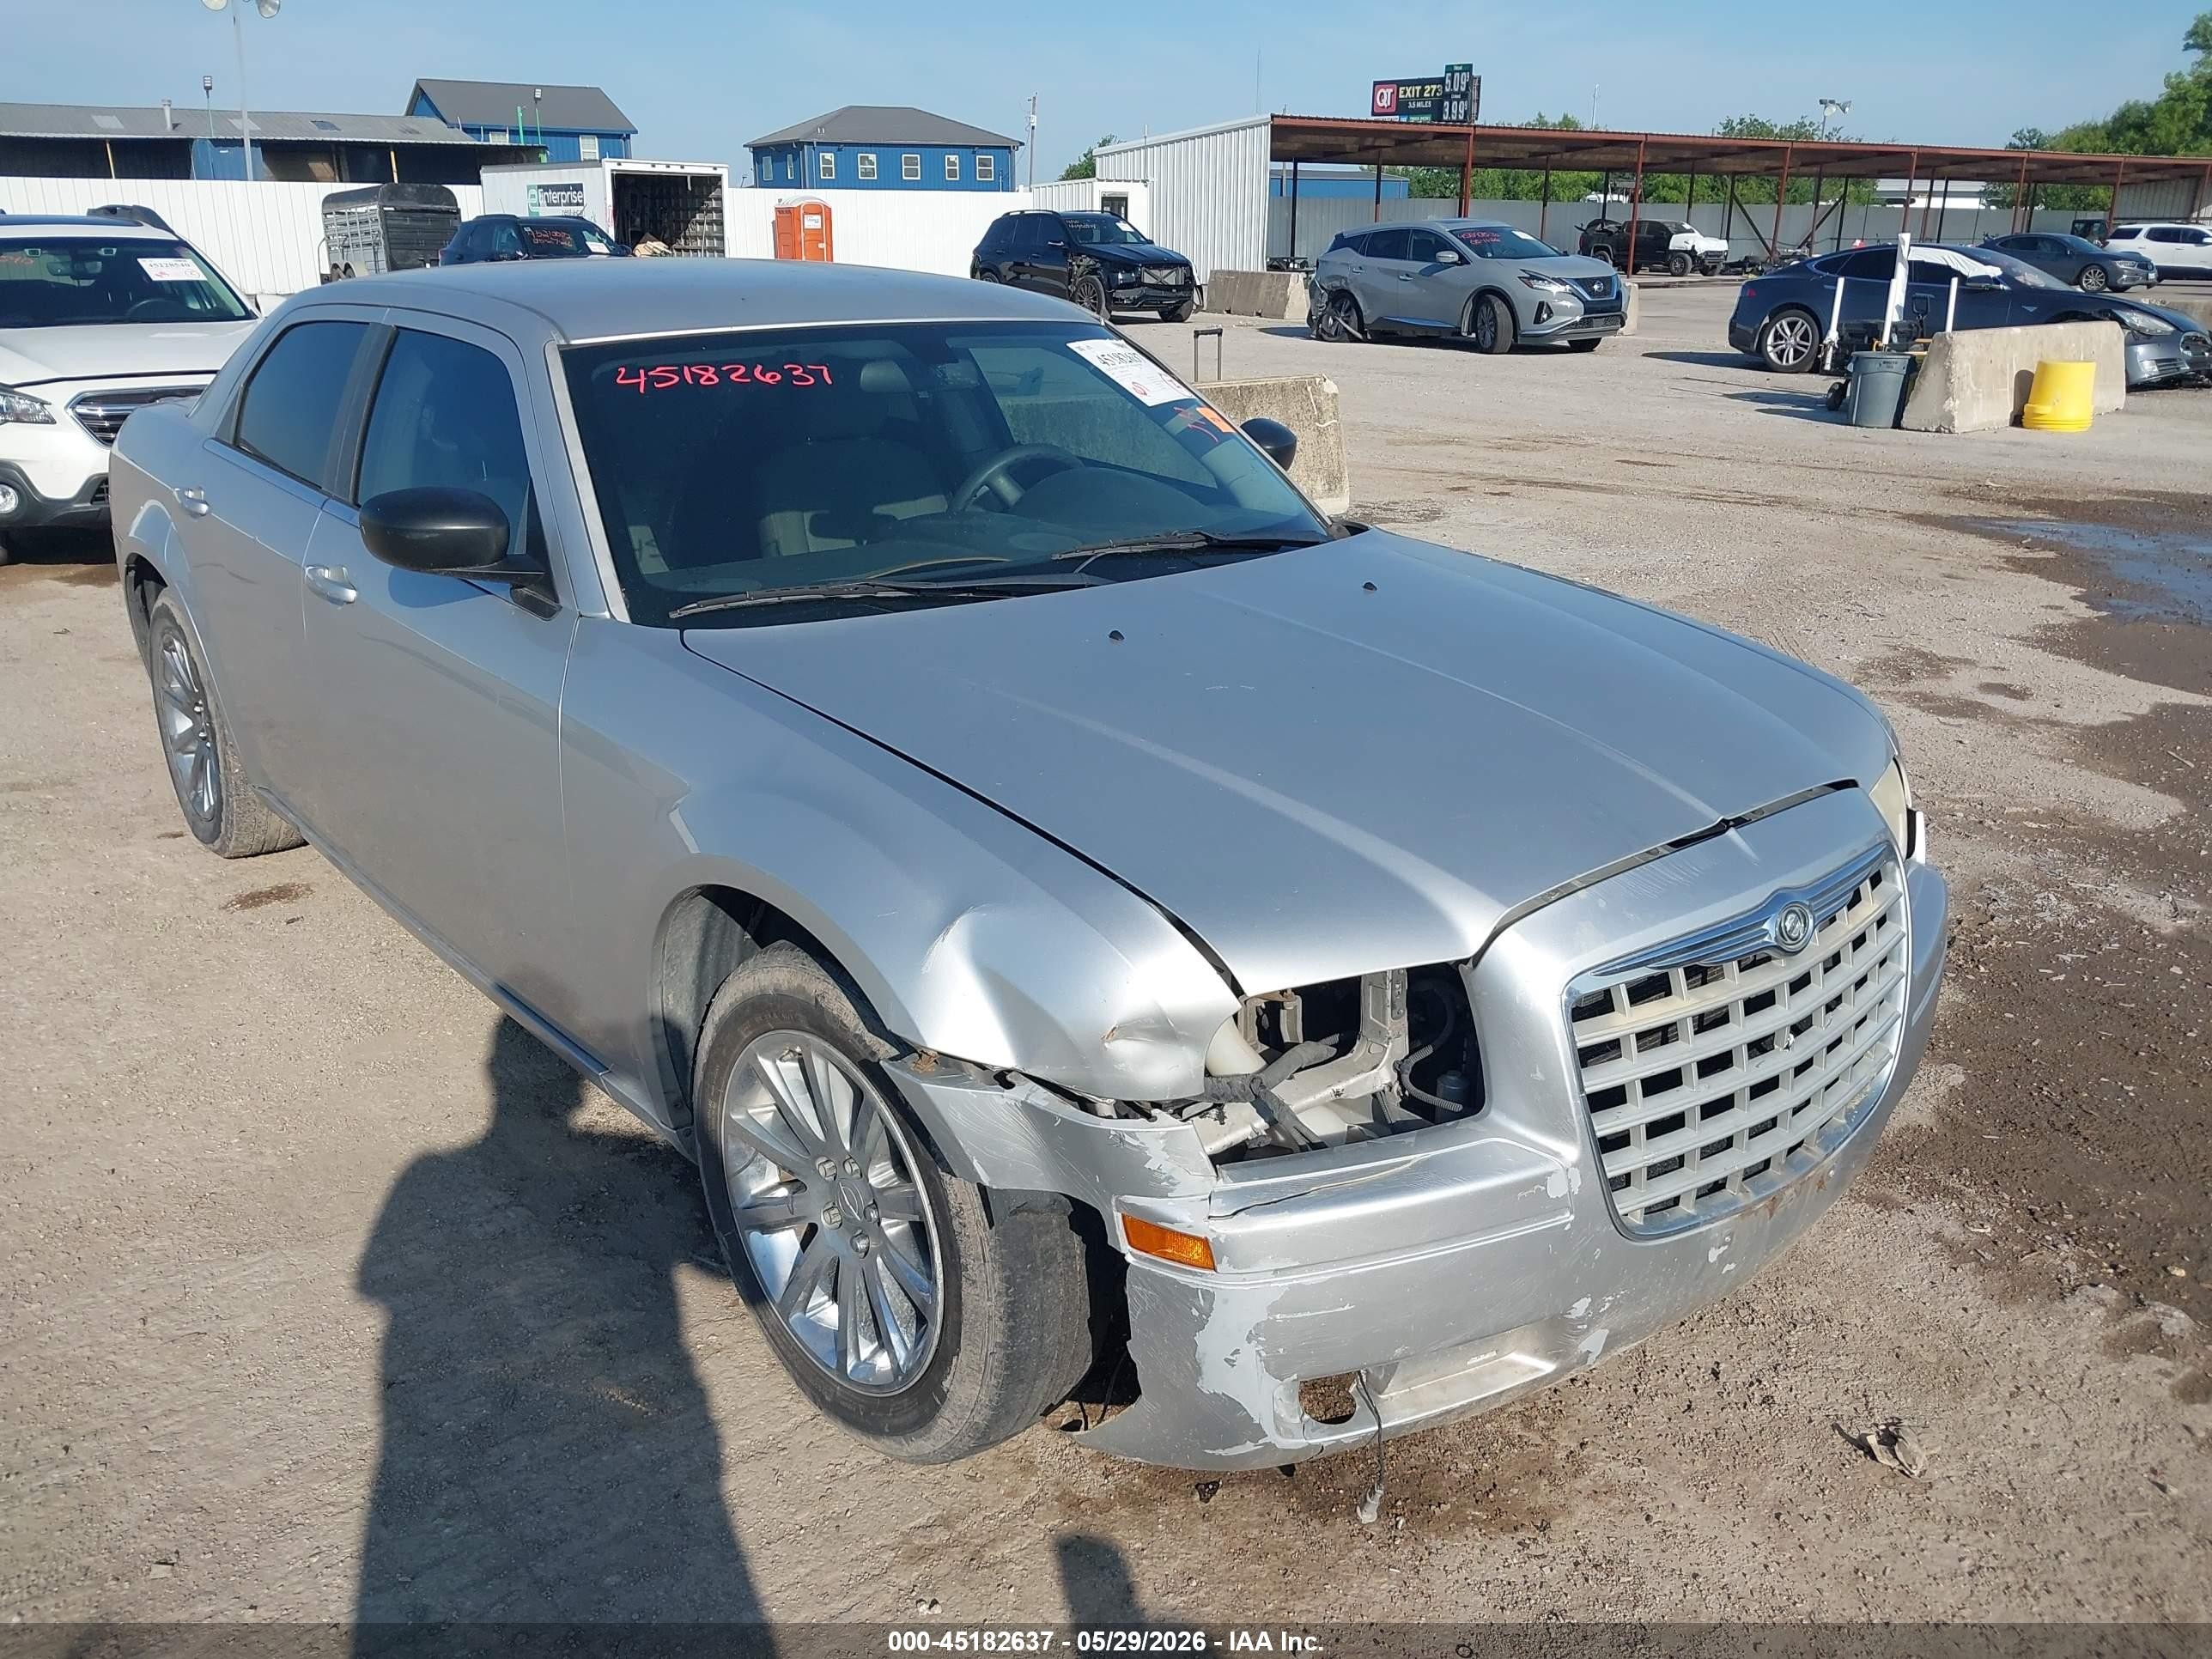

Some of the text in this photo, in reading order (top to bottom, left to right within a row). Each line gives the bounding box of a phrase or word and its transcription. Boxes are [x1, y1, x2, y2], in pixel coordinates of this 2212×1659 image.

[1376, 88, 1394, 108] QT
[1399, 87, 1422, 98] EXIT
[1423, 85, 1443, 97] 273
[616, 364, 834, 394] 45182637
